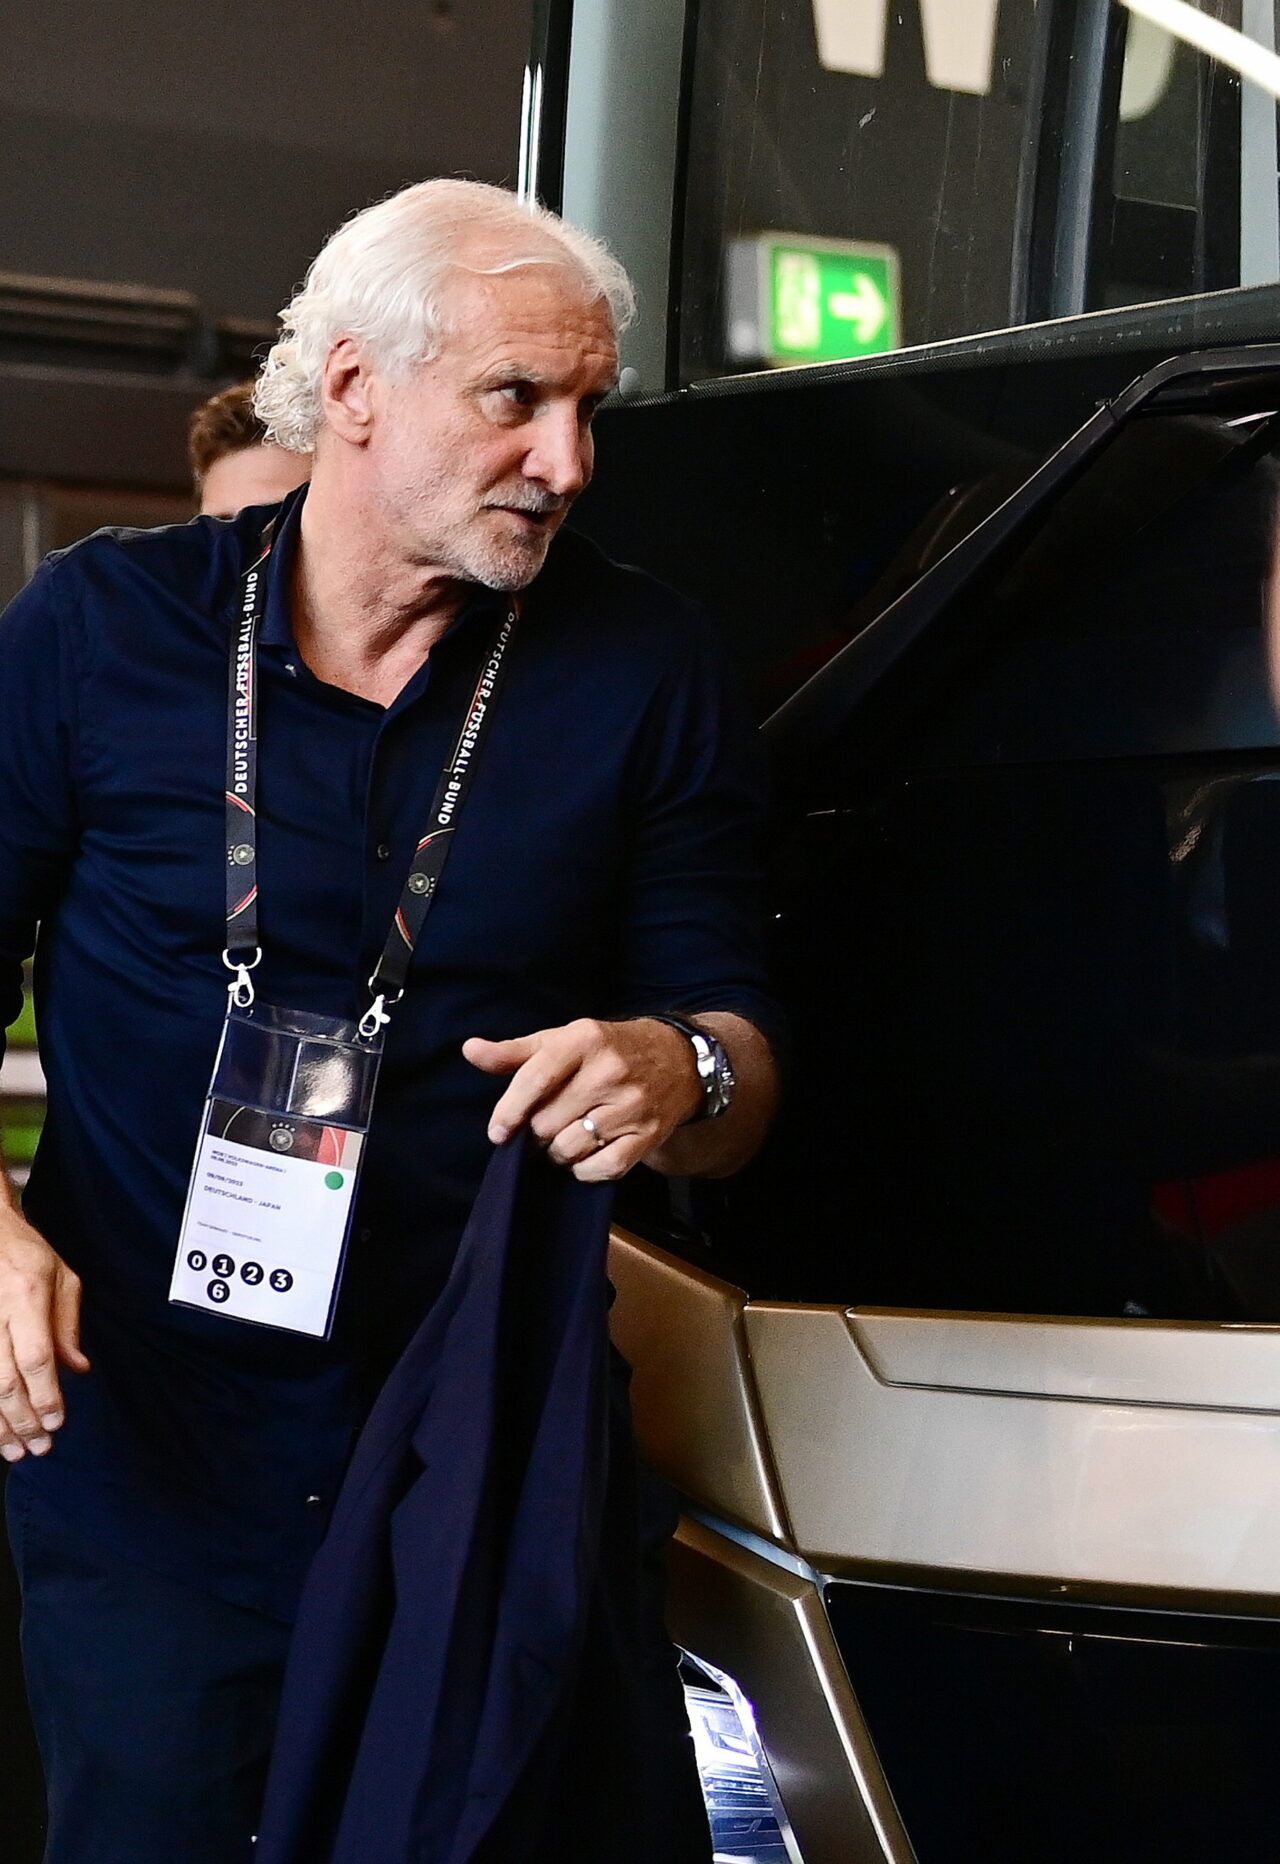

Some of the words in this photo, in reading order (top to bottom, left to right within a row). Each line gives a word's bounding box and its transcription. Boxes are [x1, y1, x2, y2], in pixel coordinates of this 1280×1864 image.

[236, 572, 259, 692] FUSSBALL-BUND
[479, 611, 515, 698] DEUTSCHER
[234, 697, 249, 793] DEUTSCHER
[437, 702, 487, 826] FUSSBALL-BUND
